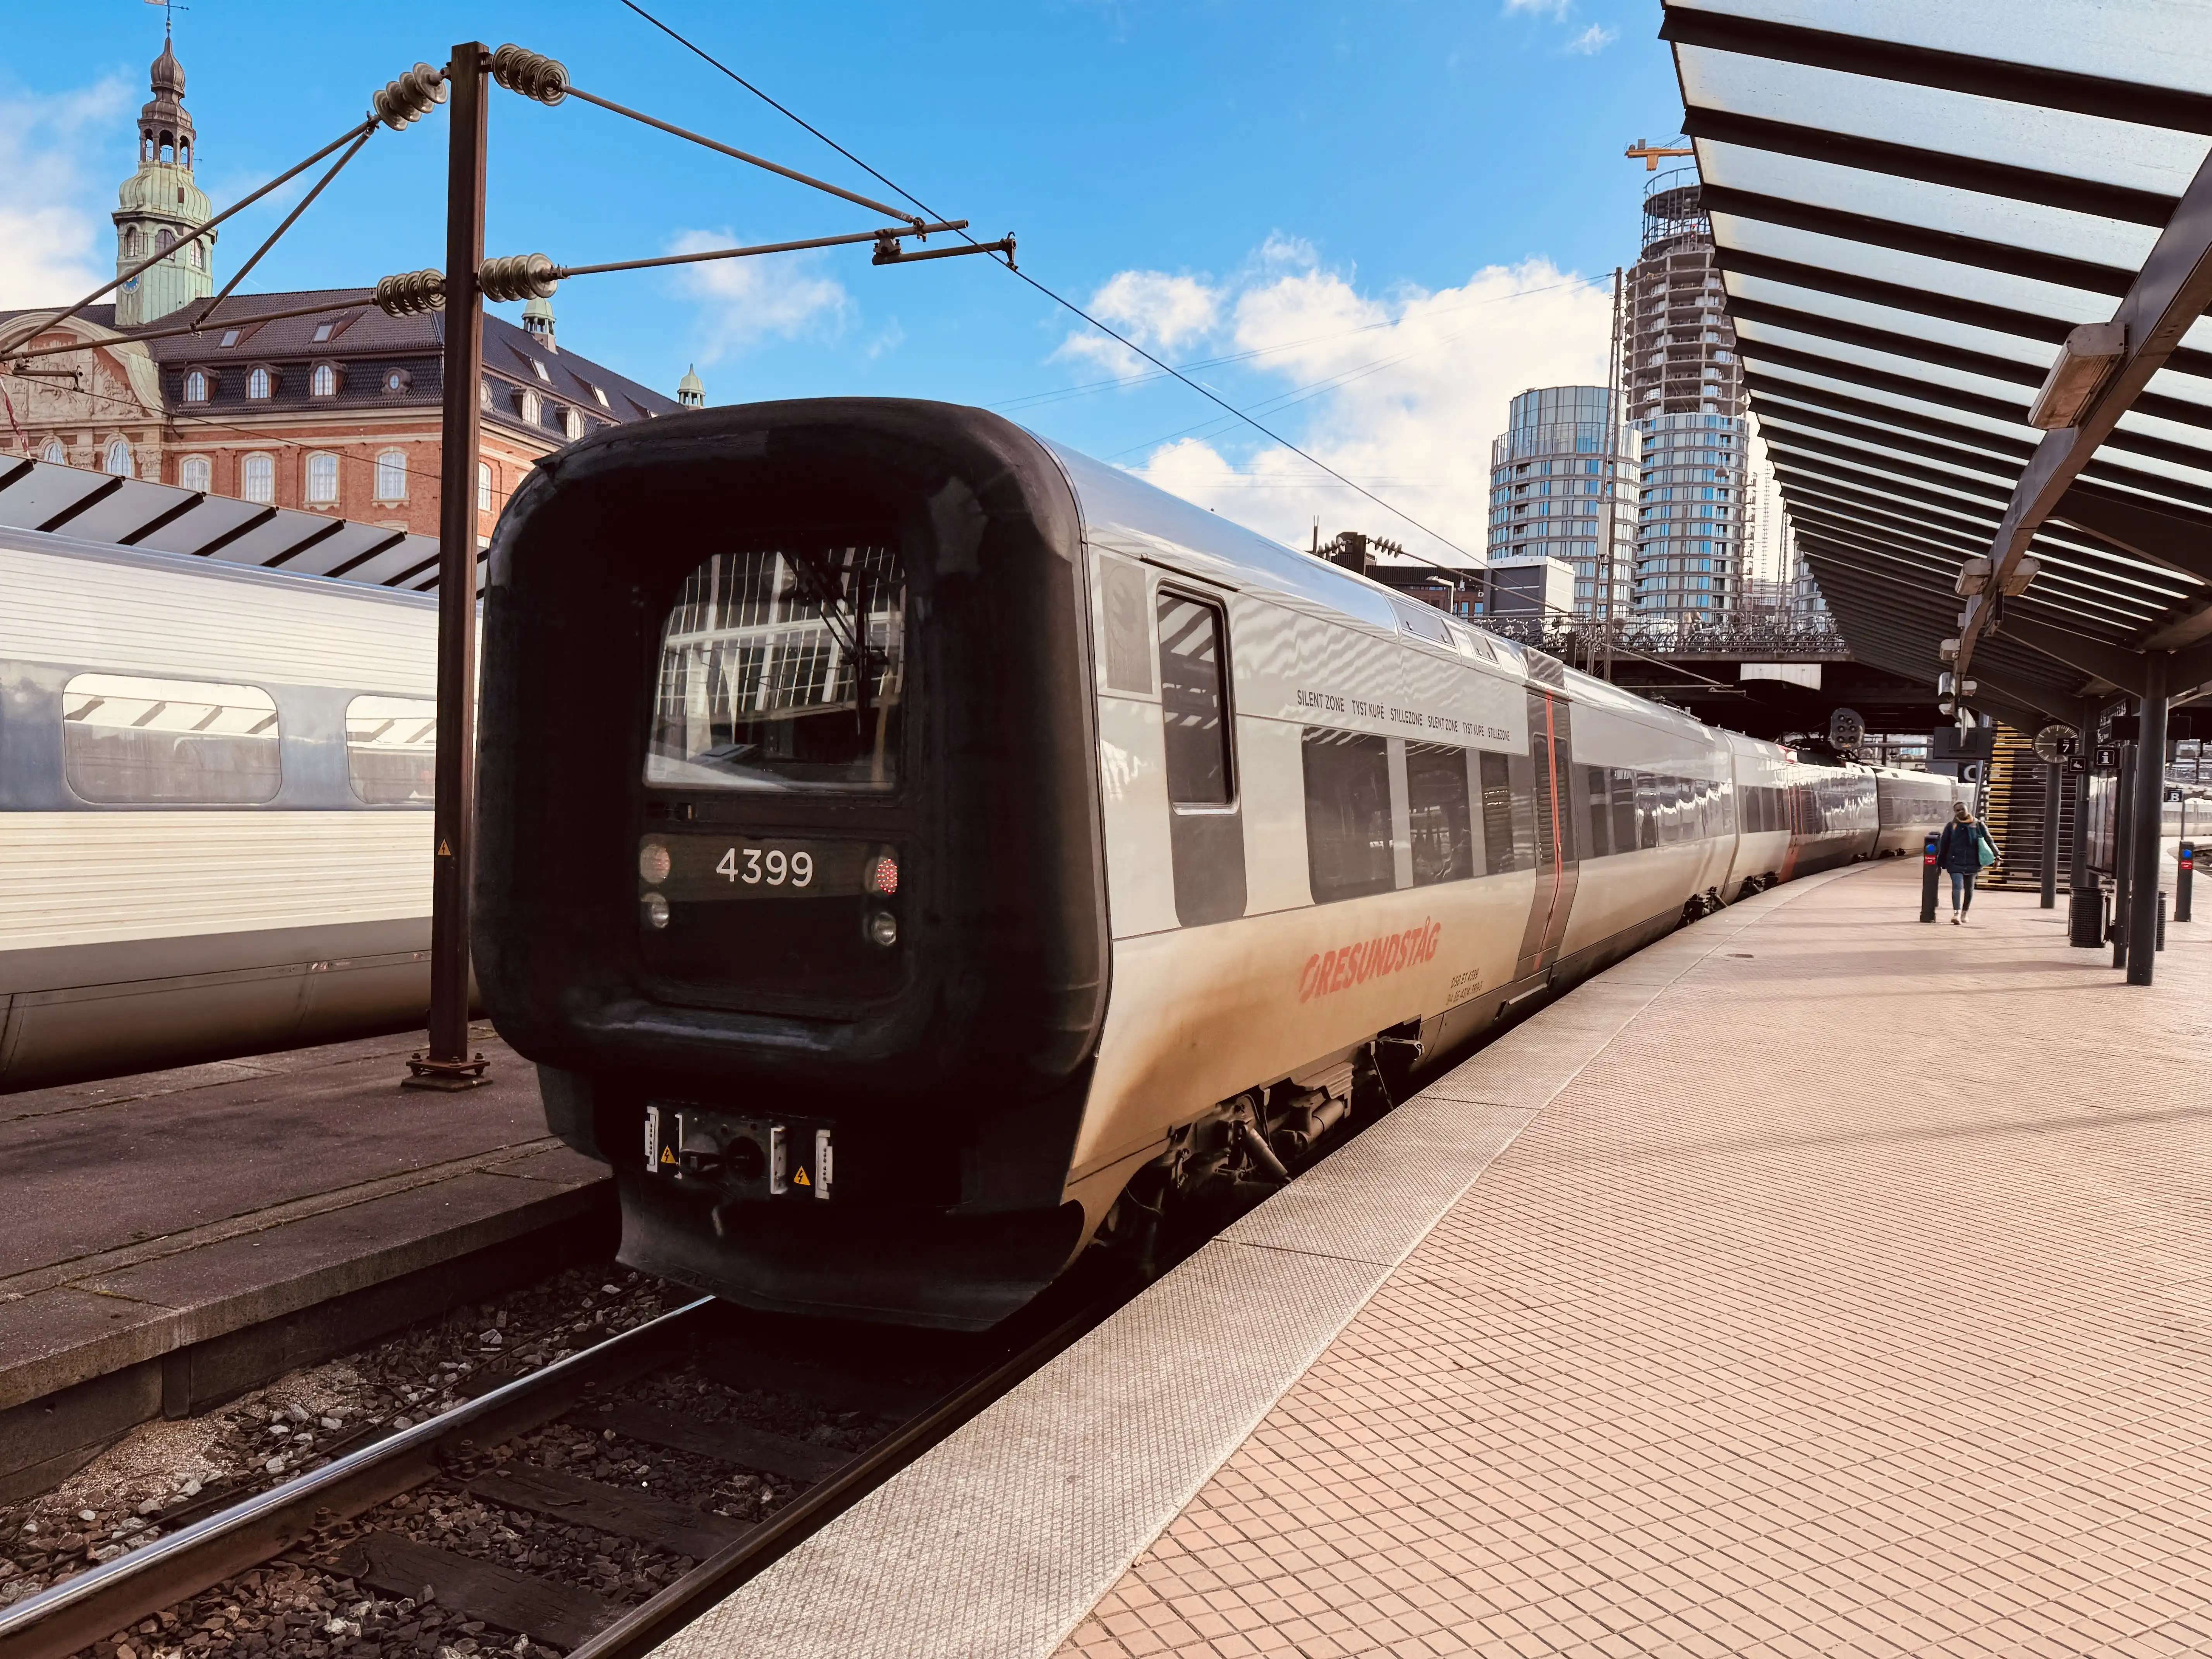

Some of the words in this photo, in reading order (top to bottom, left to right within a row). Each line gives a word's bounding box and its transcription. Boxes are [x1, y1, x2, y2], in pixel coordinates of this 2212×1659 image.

[1297, 689, 1323, 708] SILENT
[1326, 695, 1344, 712] ZONE
[1352, 700, 1367, 716] TYST
[1369, 702, 1384, 719] KUPÉ
[1391, 708, 1422, 726] STILLEZONE
[1428, 716, 1444, 730] SILENT
[1446, 719, 1458, 732] ZONE
[1463, 722, 1472, 734] TYST
[1488, 727, 1510, 741] STILLEZONE
[2063, 744, 2069, 752] 7
[2171, 793, 2179, 802] B
[716, 848, 813, 887] 4399
[1298, 915, 1441, 1004] ØRESUNDSTÅG
